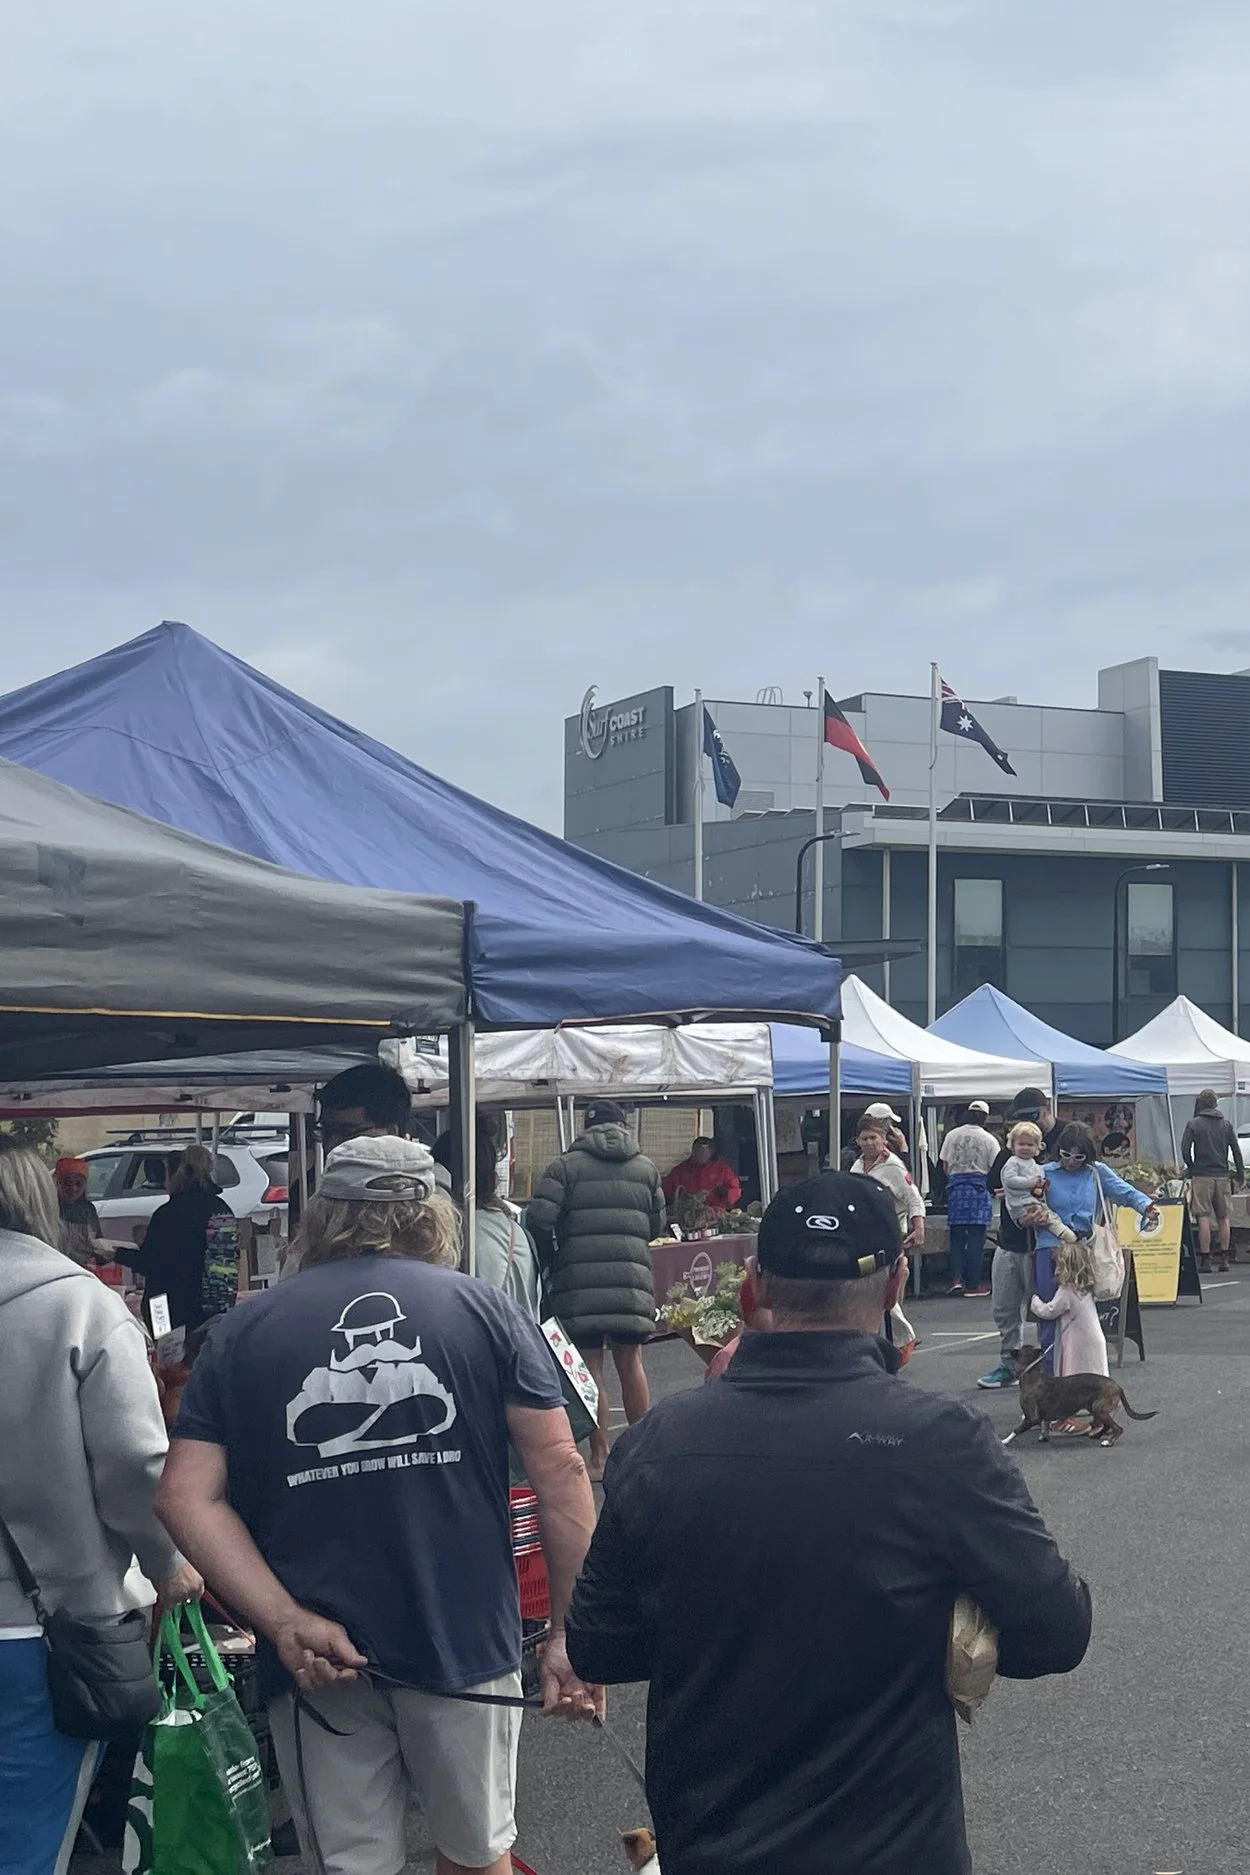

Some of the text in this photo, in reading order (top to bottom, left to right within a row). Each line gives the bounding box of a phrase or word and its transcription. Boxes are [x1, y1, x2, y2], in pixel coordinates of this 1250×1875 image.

[609, 706, 645, 732] COAST
[610, 727, 645, 746] SHIRE
[287, 1465, 339, 1487] WHATEVER
[340, 1462, 360, 1476] YOU
[387, 1454, 411, 1468] WILL
[411, 1452, 436, 1465] SAVE
[437, 1451, 443, 1464] A
[443, 1450, 462, 1462] BRO
